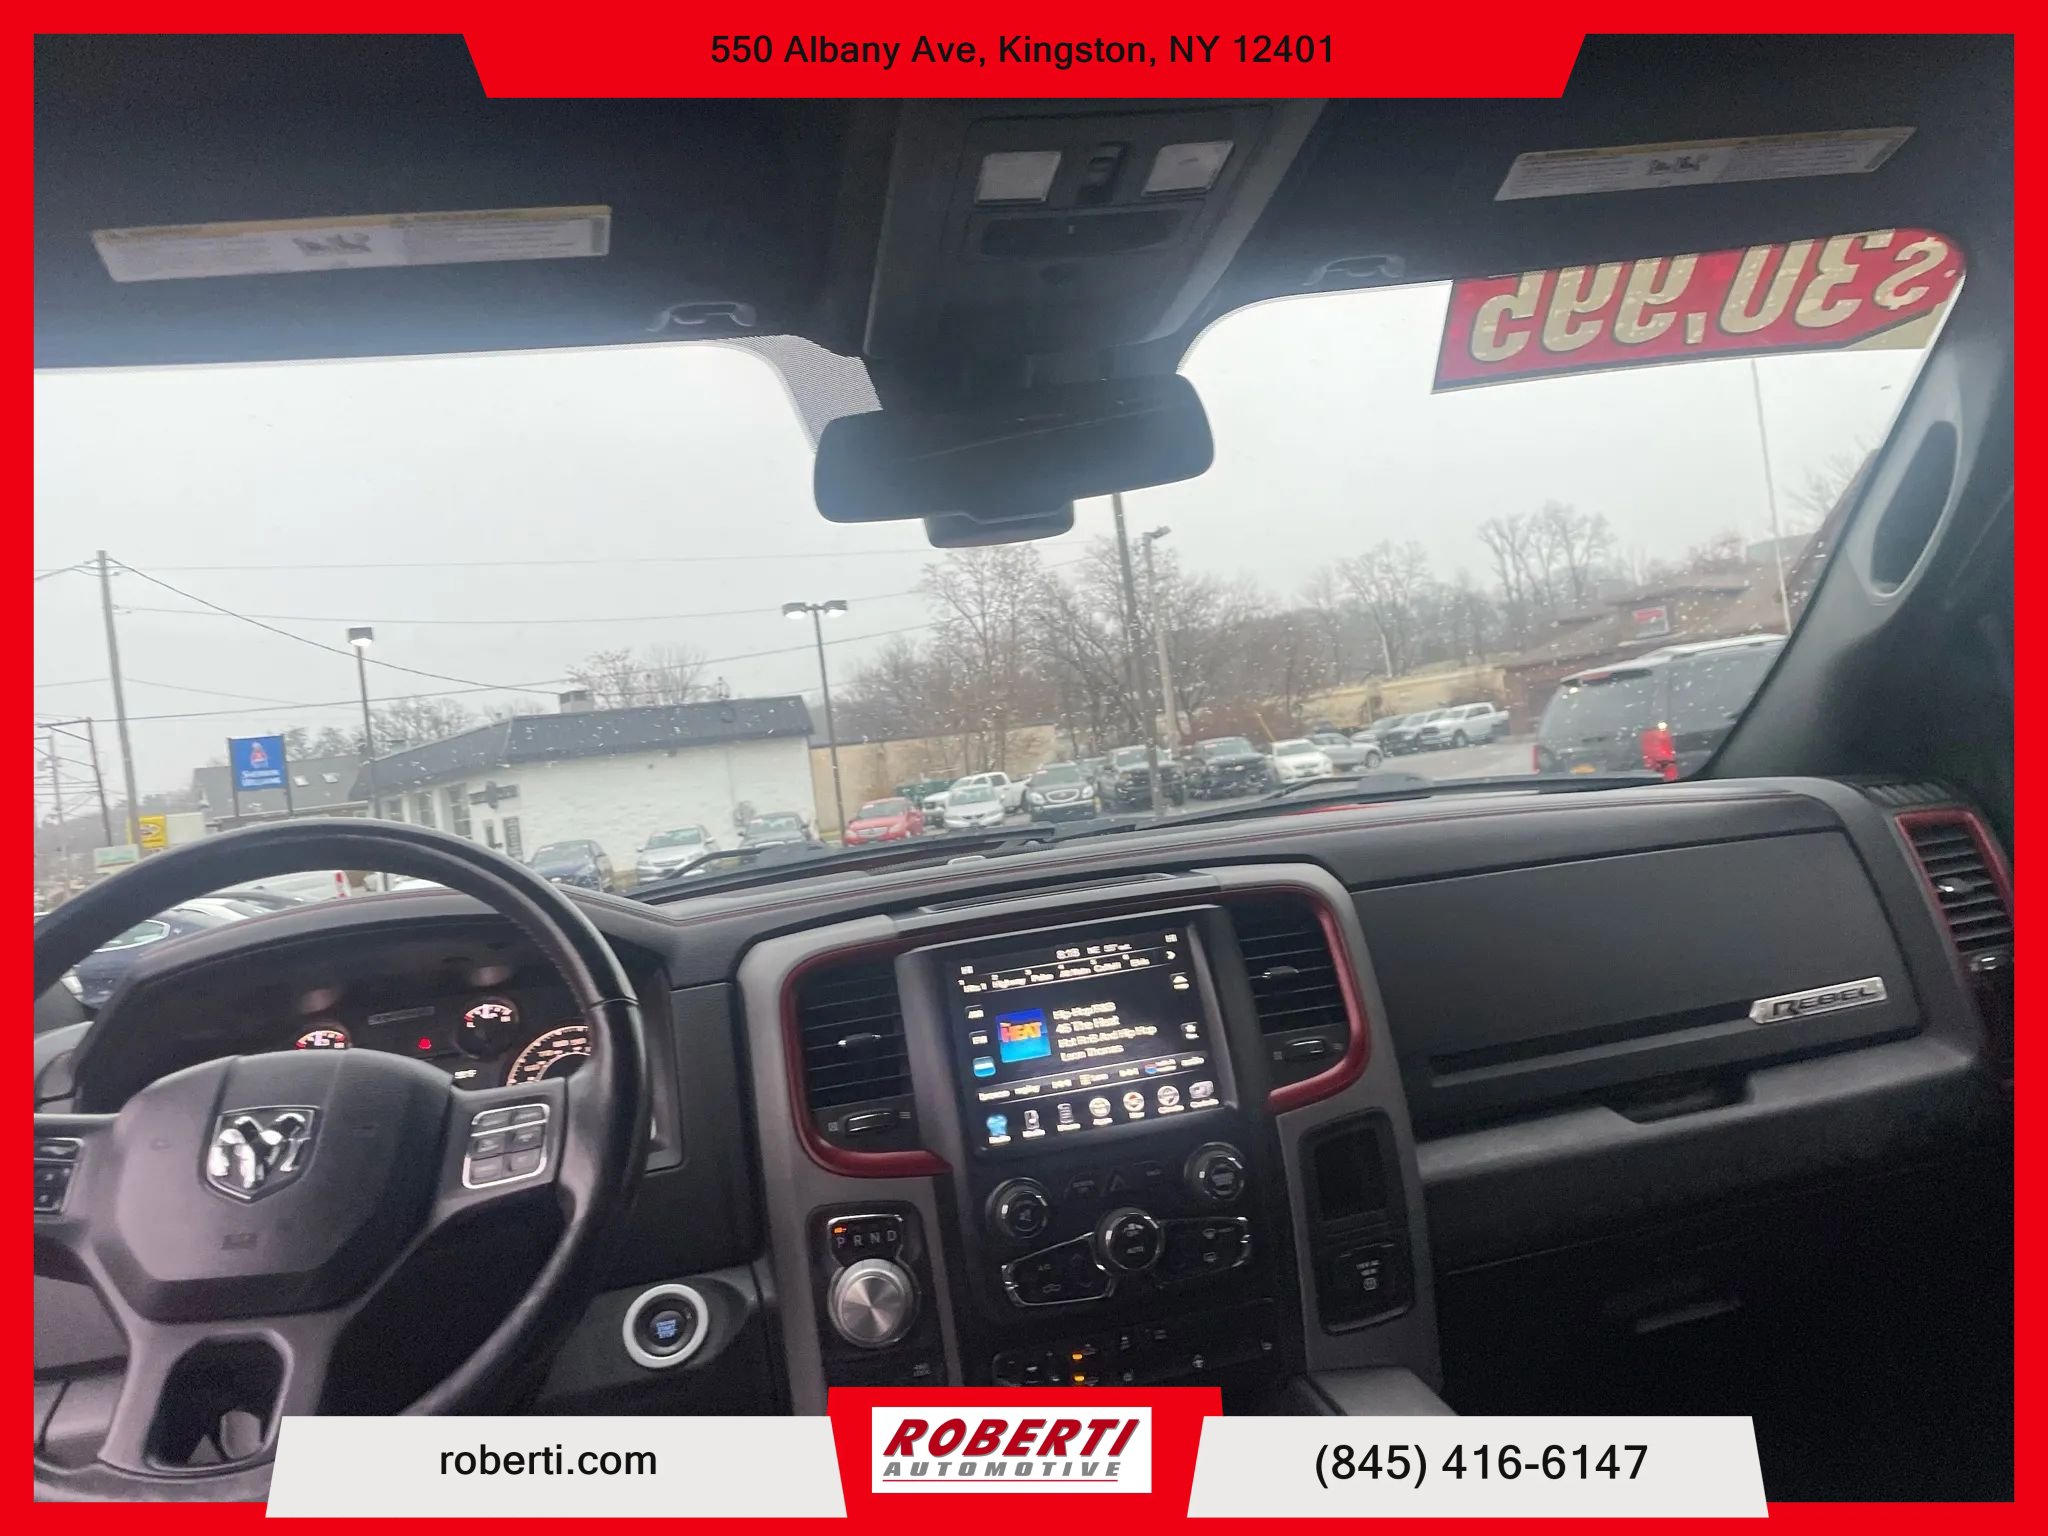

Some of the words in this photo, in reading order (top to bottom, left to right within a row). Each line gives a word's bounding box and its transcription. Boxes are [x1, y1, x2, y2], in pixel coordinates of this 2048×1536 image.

[1772, 986, 1880, 1016] REBEL
[836, 1236, 845, 1248] P
[853, 1234, 864, 1246] R
[870, 1232, 881, 1244] N
[887, 1230, 897, 1242] D
